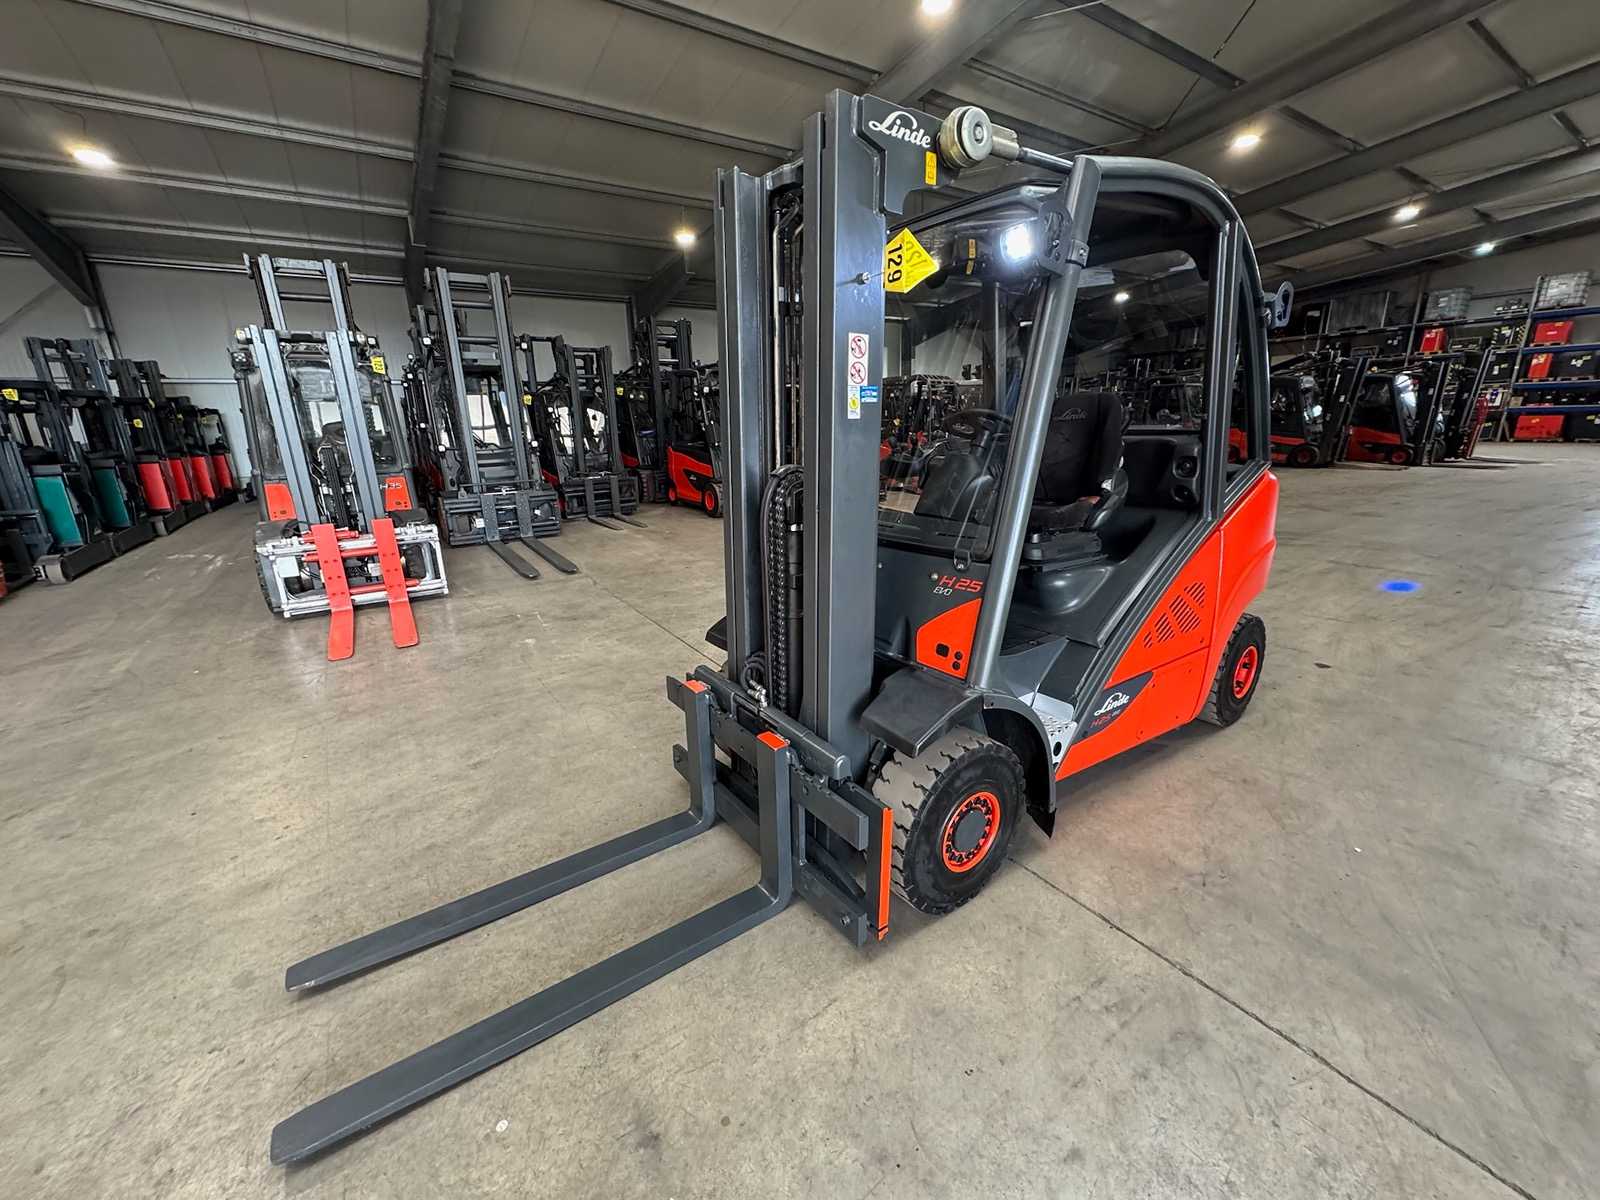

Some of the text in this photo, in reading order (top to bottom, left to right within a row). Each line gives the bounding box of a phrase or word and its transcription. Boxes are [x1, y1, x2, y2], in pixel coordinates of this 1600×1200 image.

[868, 110, 931, 148] Linde
[887, 243, 903, 284] 129
[1093, 692, 1130, 717] Linde
